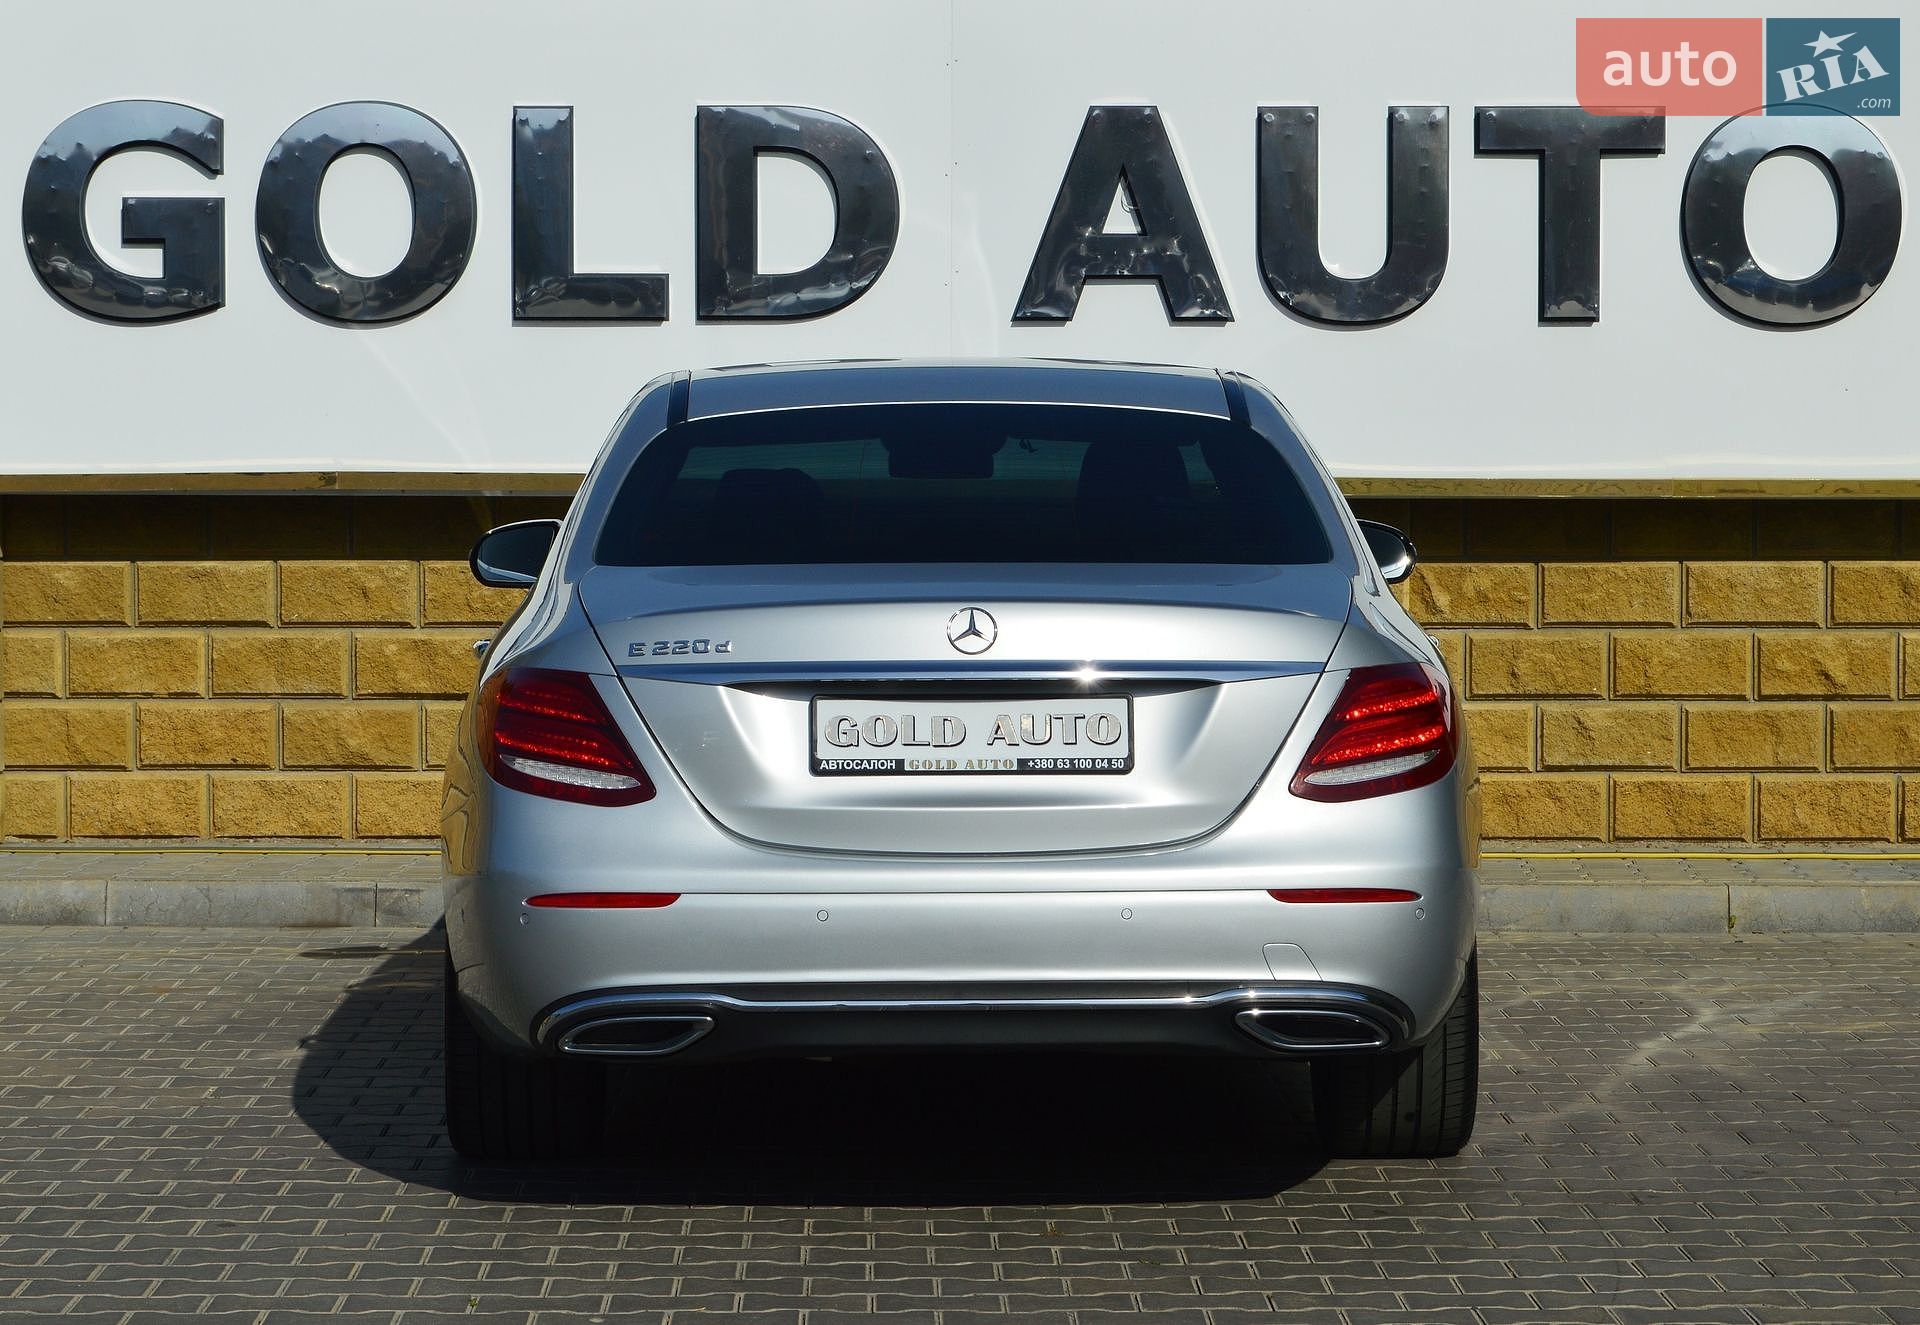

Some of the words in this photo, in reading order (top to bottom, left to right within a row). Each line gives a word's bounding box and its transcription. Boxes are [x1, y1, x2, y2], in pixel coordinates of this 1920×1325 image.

[22, 99, 900, 324] GOLD
[1011, 103, 1903, 327] AUTO
[824, 714, 967, 748] GOLD
[986, 712, 1122, 746] AUTO
[819, 759, 896, 770] АВТОСАЛОН
[908, 759, 958, 770] GOLD
[964, 759, 1014, 770] AUTO
[1027, 759, 1052, 768] +380
[1056, 759, 1070, 768] 63
[1073, 759, 1092, 768] 100
[1095, 759, 1109, 768] 04
[1111, 759, 1124, 768] 50
